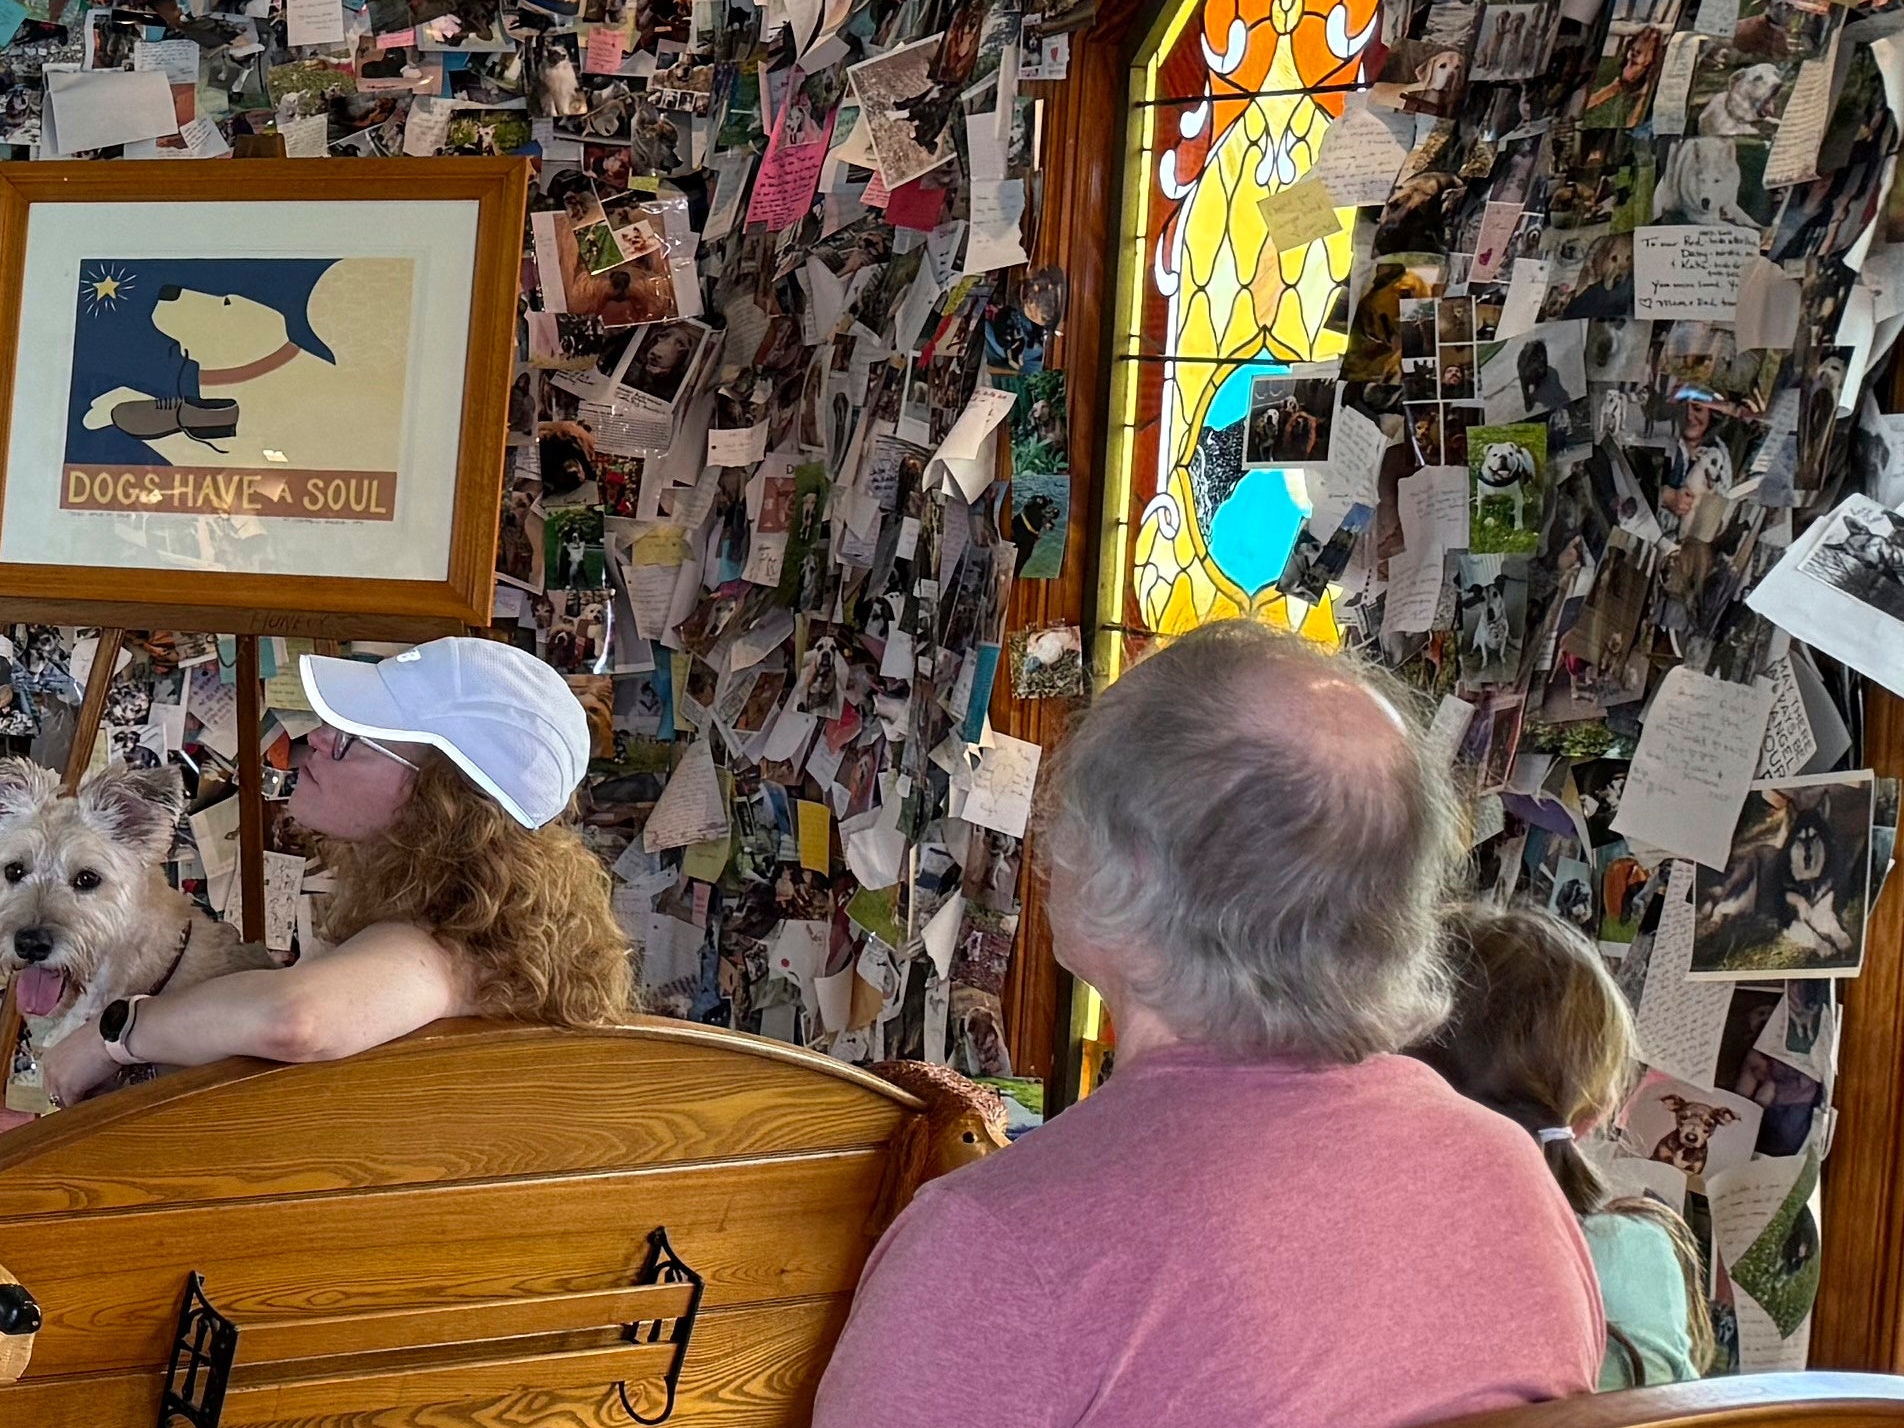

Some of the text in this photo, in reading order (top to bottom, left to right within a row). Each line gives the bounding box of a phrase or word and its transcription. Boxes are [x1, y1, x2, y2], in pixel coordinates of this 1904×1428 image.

[67, 470, 387, 514] DOGS HAVE A SOUL
[1779, 655, 1813, 753] MAY THERE
